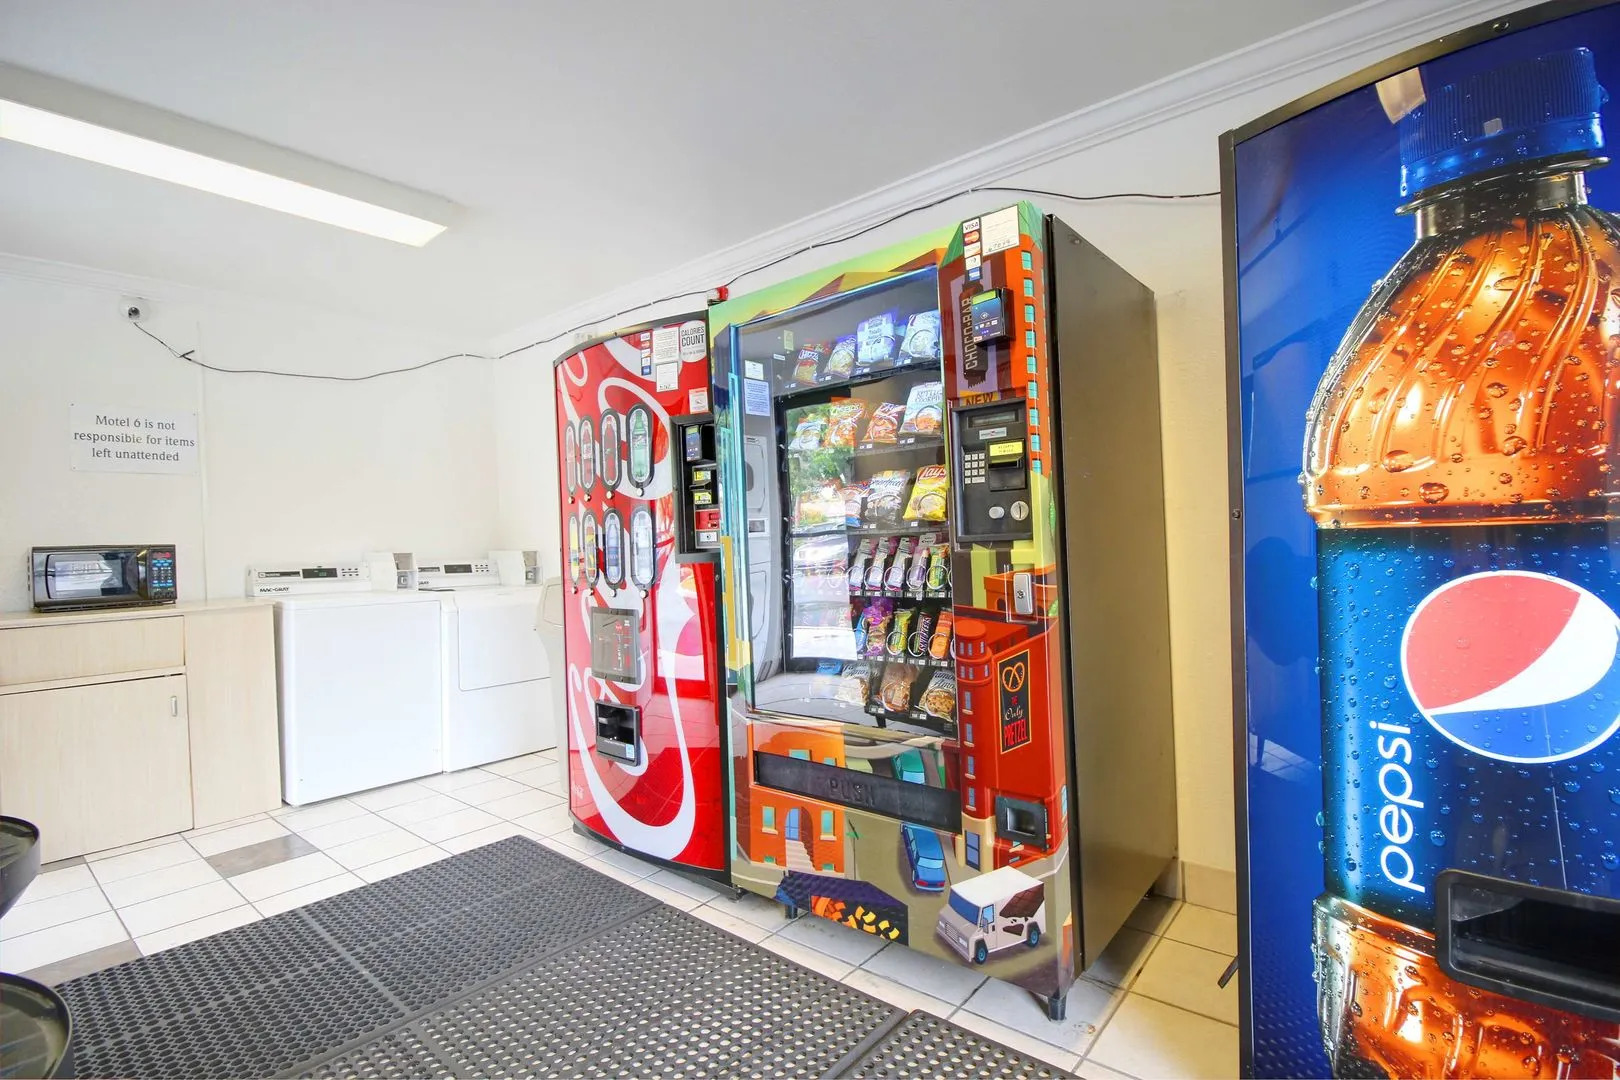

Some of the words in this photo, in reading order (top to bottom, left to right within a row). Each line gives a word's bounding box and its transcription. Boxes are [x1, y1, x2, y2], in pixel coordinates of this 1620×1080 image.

[965, 222, 979, 231] VISA
[681, 327, 705, 337] CALORIES
[681, 334, 705, 347] COUNT
[965, 392, 994, 406] NEW
[95, 415, 130, 428] Motel
[134, 419, 141, 428] 6
[144, 419, 154, 429] is
[157, 421, 176, 431] not
[73, 432, 143, 444] responsible
[146, 434, 162, 446] for
[165, 436, 195, 447] items
[92, 448, 112, 459] left
[115, 450, 179, 461] unattended
[918, 616, 932, 653] SNICKERS
[1004, 705, 1024, 720] Only
[1004, 719, 1028, 749] PRETZEL
[827, 776, 875, 808] PUSH
[1369, 720, 1425, 892] pepsi
